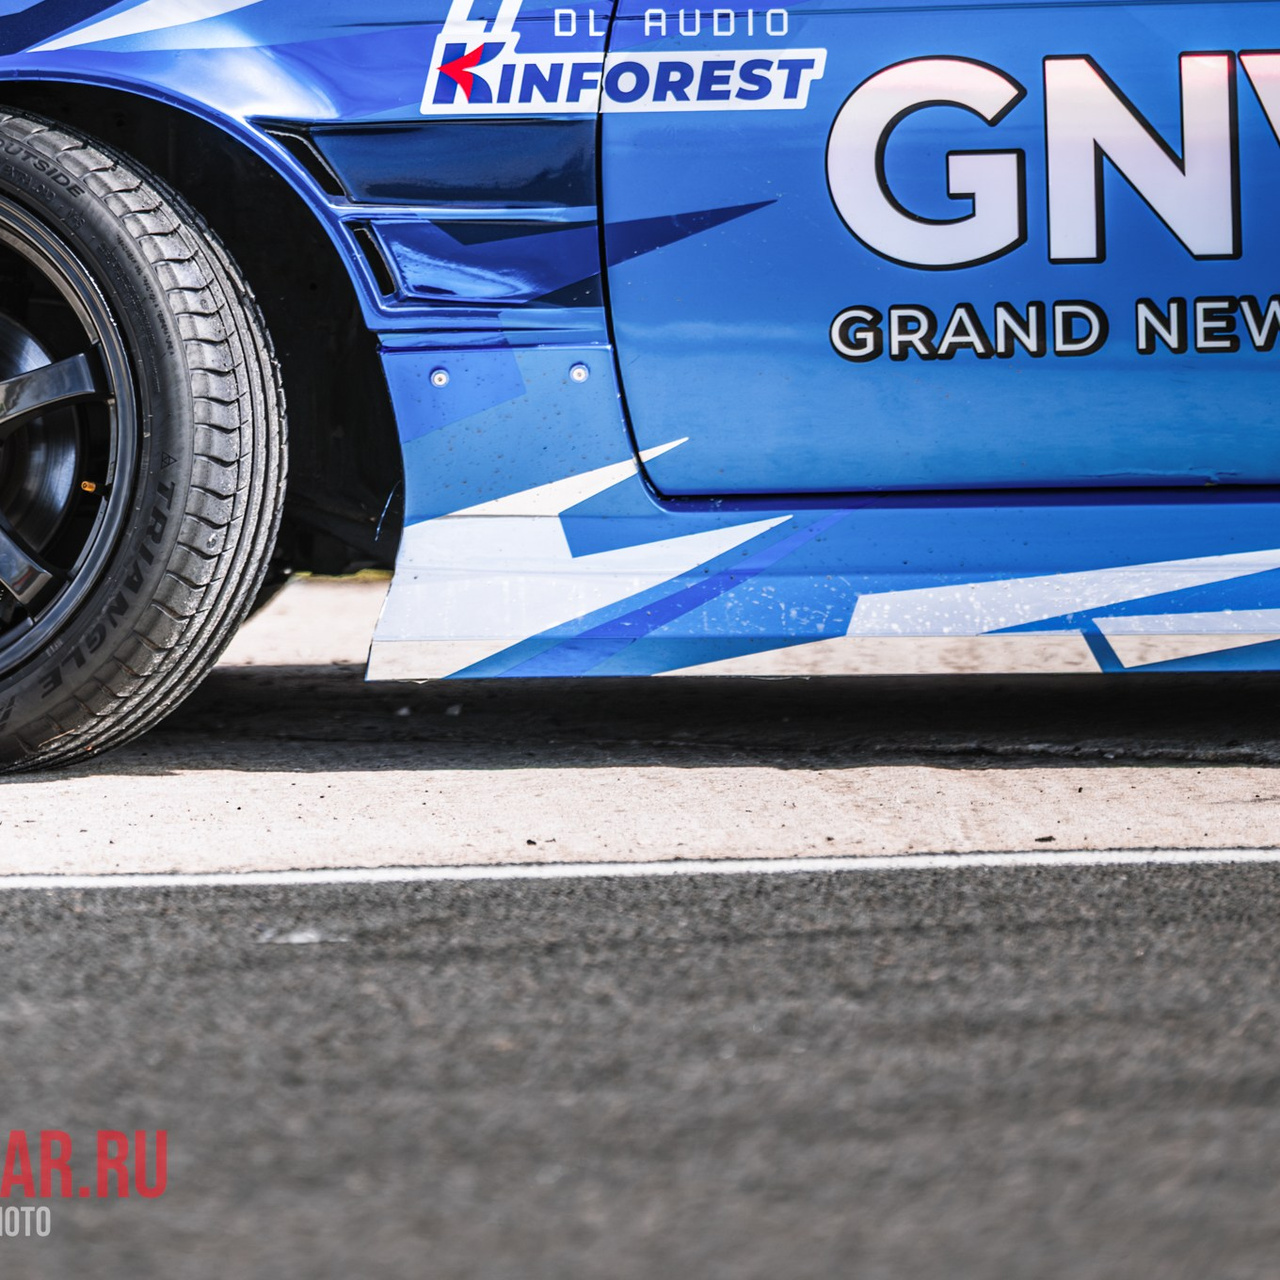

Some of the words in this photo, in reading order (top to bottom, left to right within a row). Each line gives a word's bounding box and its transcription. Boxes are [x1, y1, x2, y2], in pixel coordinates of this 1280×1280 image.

[554, 7, 605, 37] DL
[643, 7, 790, 37] AUDIO
[431, 41, 816, 105] KINFOREST
[825, 50, 1280, 271] GN
[830, 299, 1108, 362] GRAND
[37, 481, 176, 699] TRIANGLE
